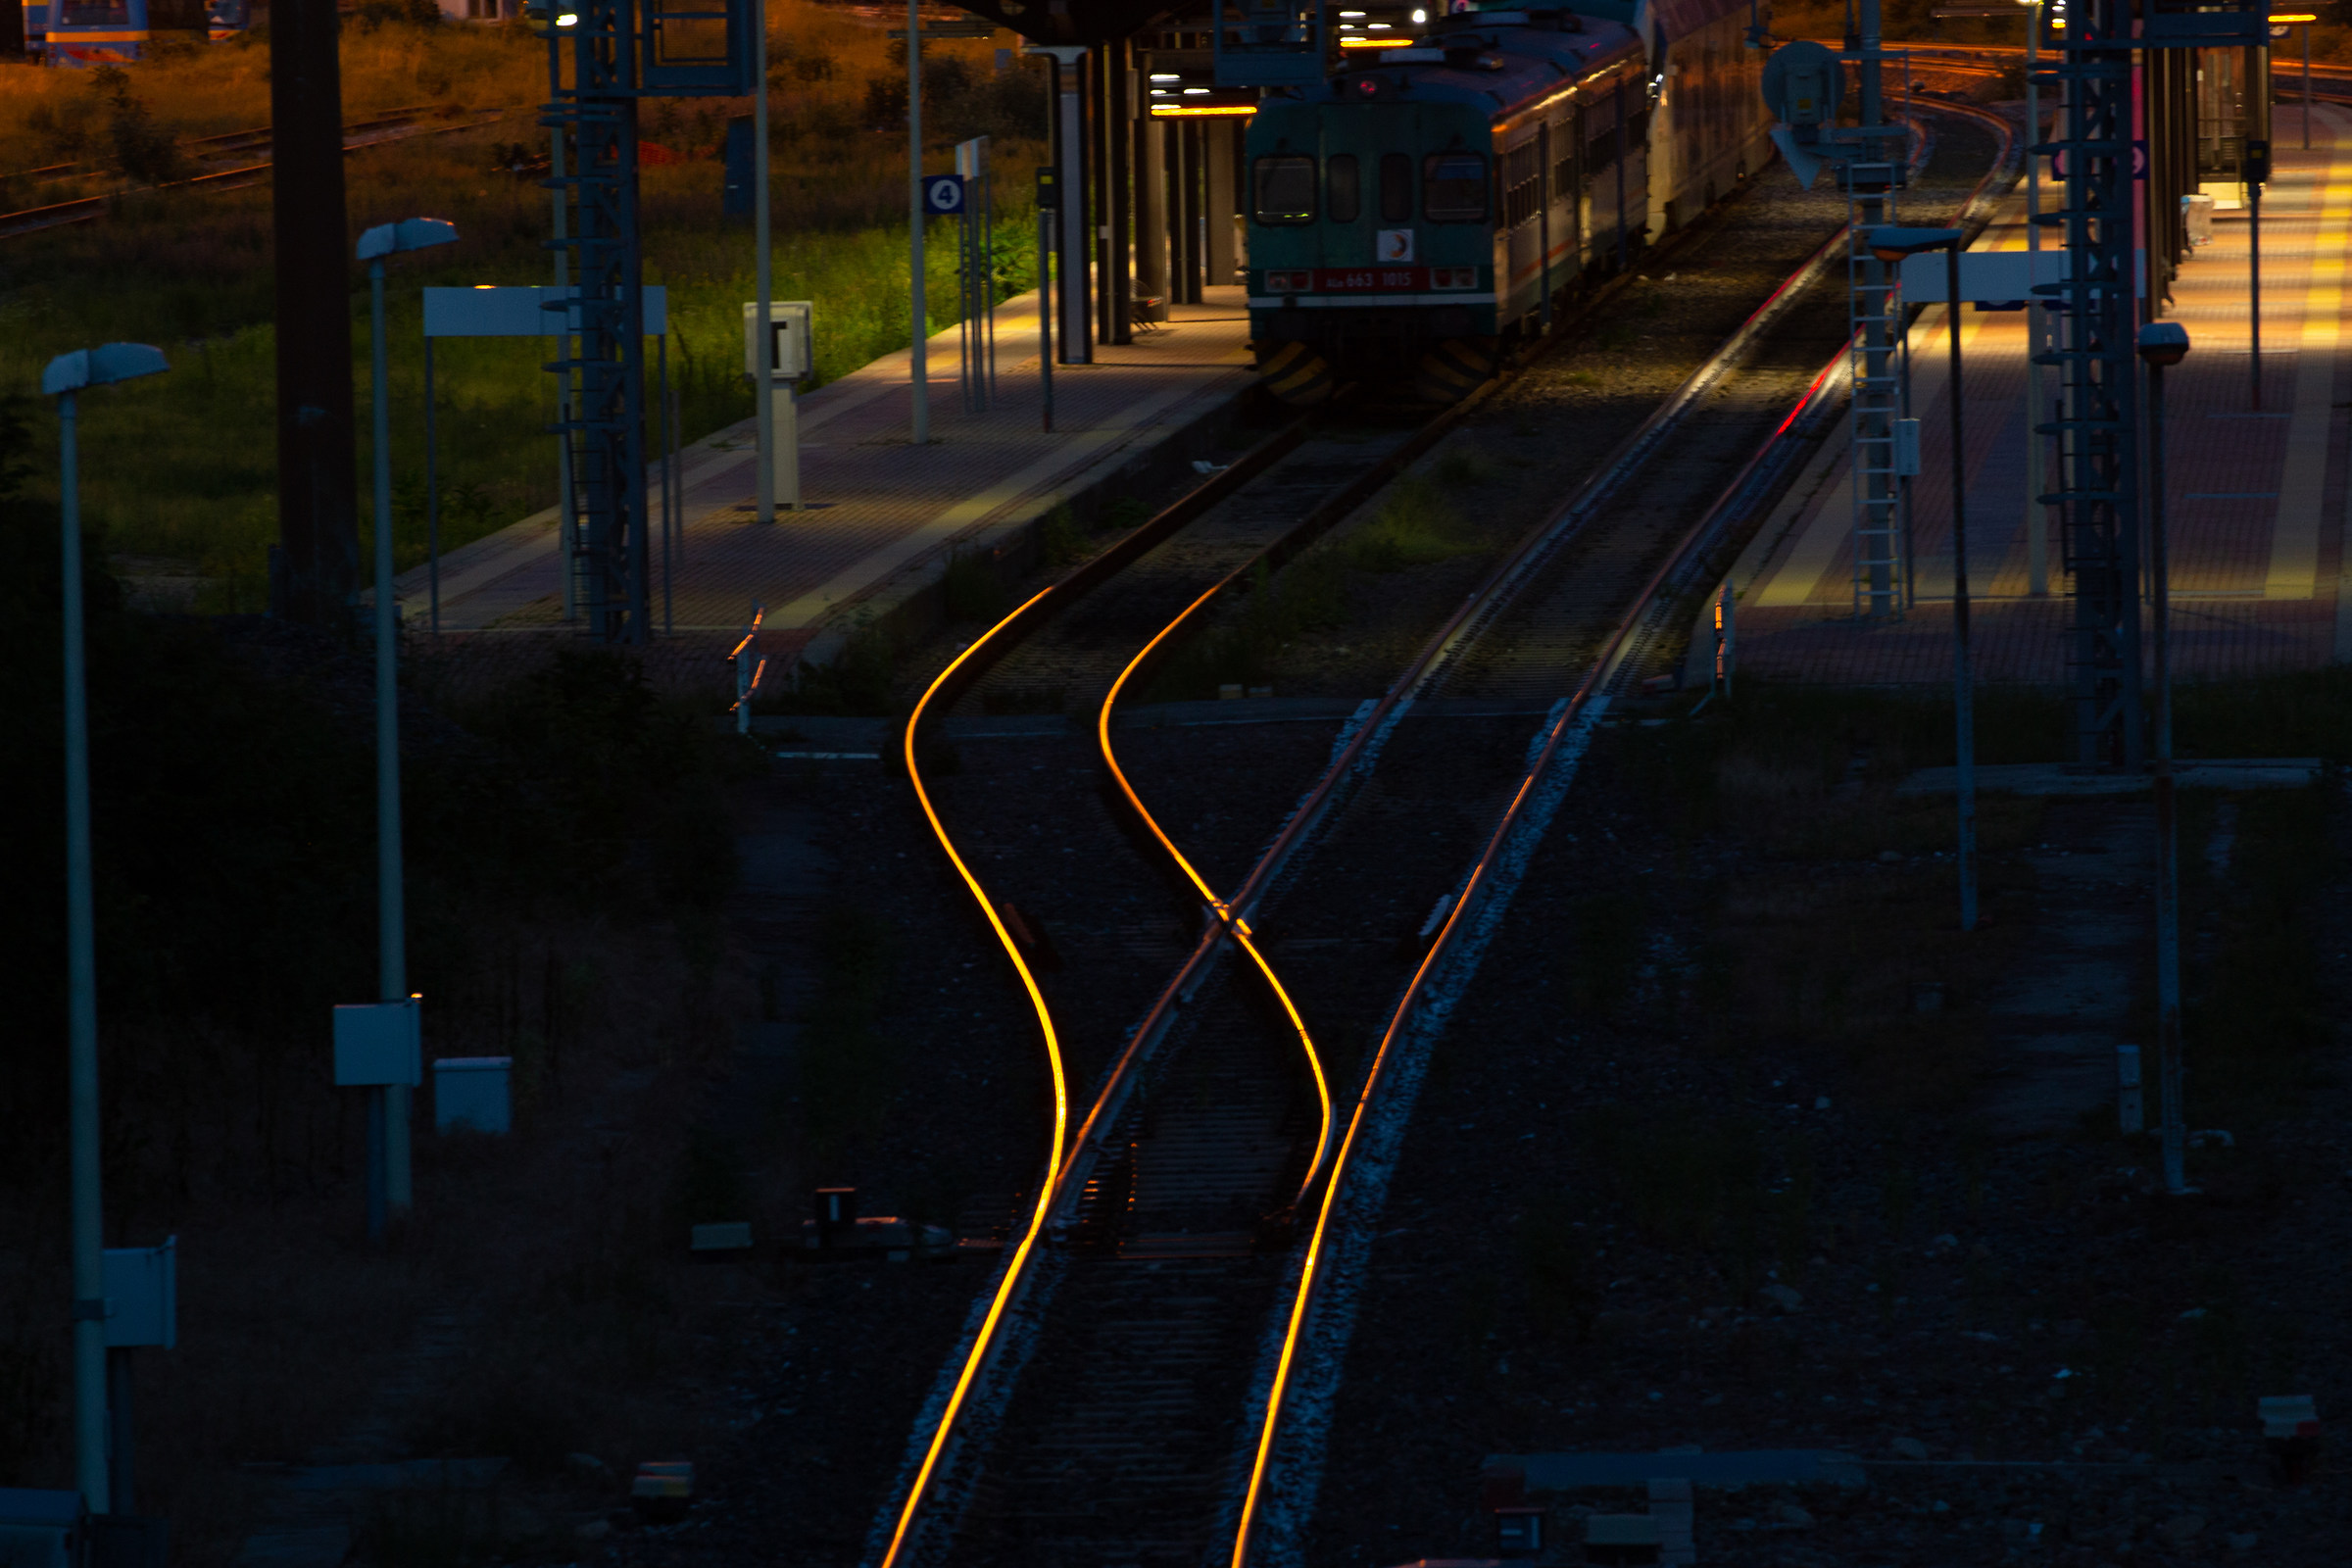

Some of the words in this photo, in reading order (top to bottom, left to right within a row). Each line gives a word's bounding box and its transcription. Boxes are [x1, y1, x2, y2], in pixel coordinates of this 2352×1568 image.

[938, 185, 954, 205] 4
[1347, 272, 1374, 287] 663
[1382, 271, 1412, 286] 1015
